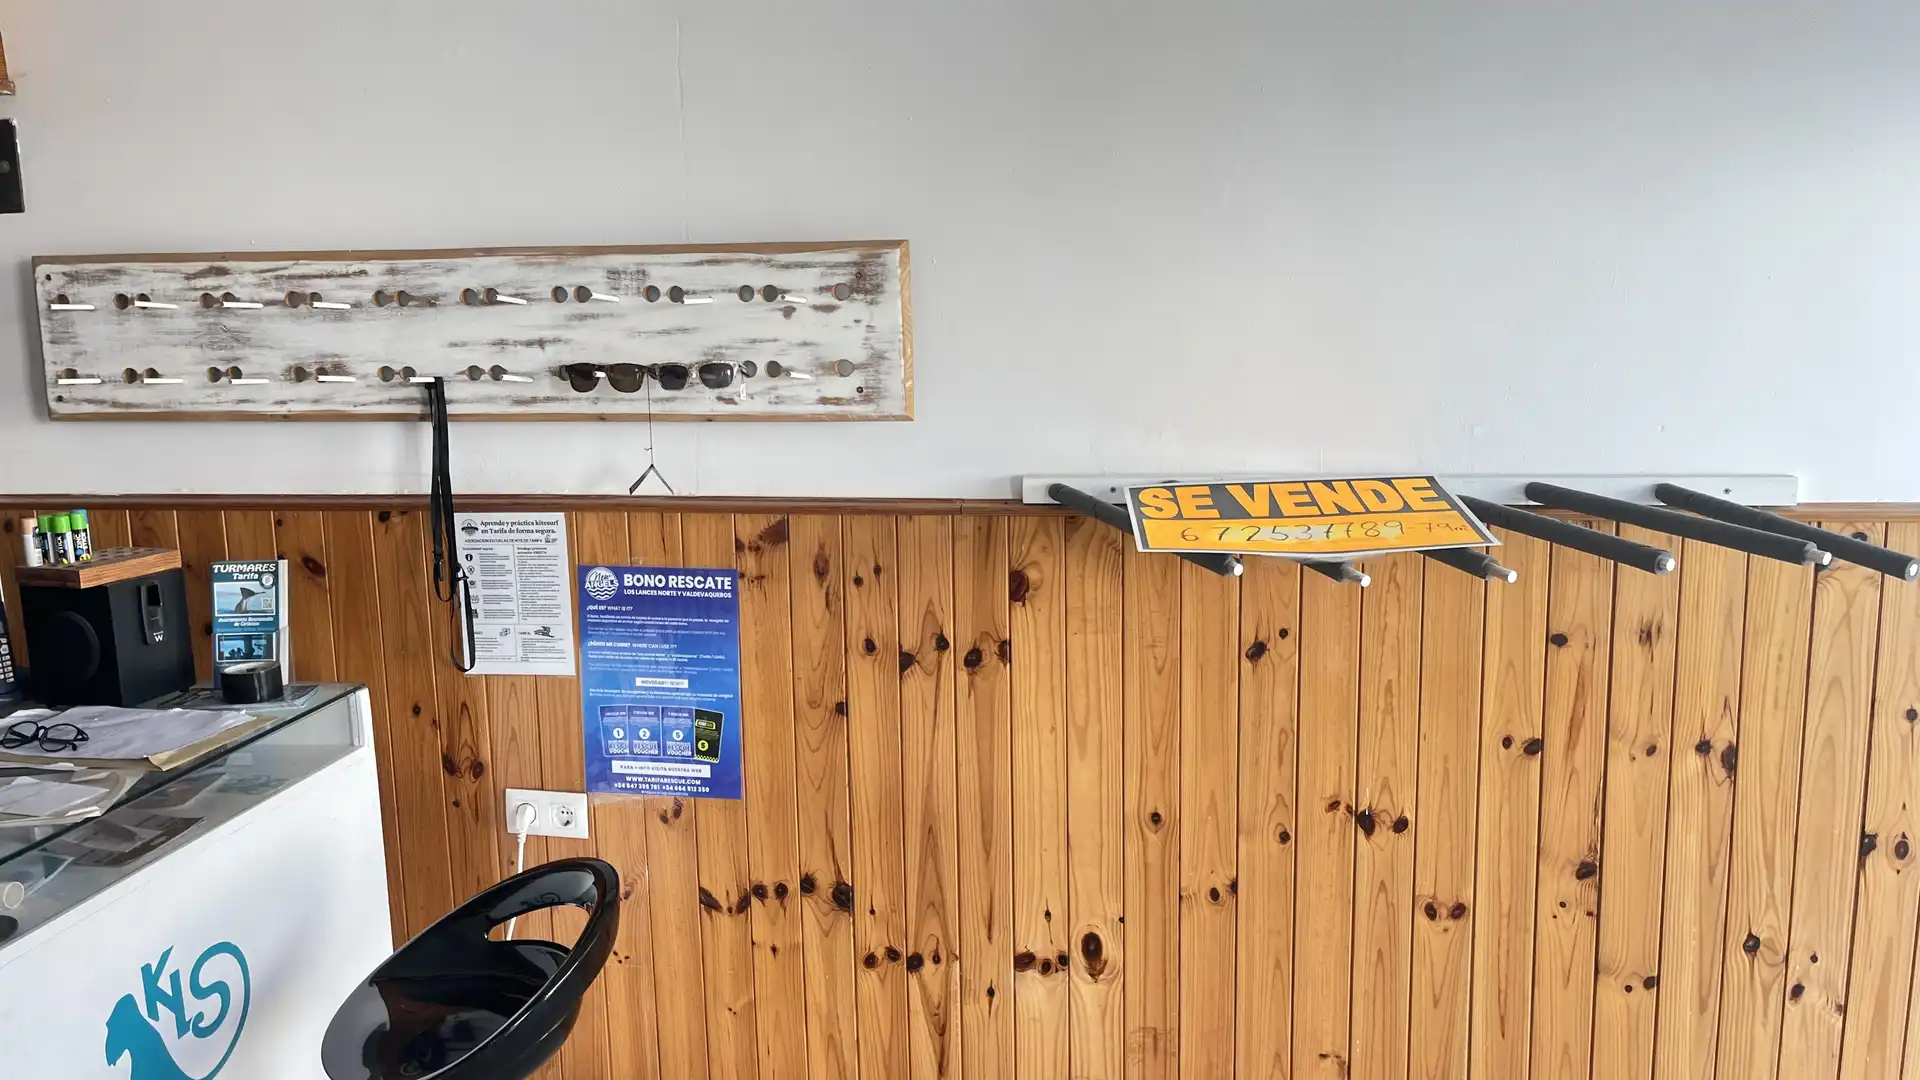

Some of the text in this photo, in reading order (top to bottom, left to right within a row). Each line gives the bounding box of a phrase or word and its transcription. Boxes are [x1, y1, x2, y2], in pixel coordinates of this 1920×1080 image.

[1138, 478, 1451, 519] SE VENDE
[212, 563, 276, 573] TURMARES
[232, 572, 259, 580] Tarifa
[623, 573, 732, 590] BONO RESCATE
[681, 590, 732, 598] VALDEVAQUEROS
[625, 775, 701, 784] WWW.TARIFARESCUE.COM
